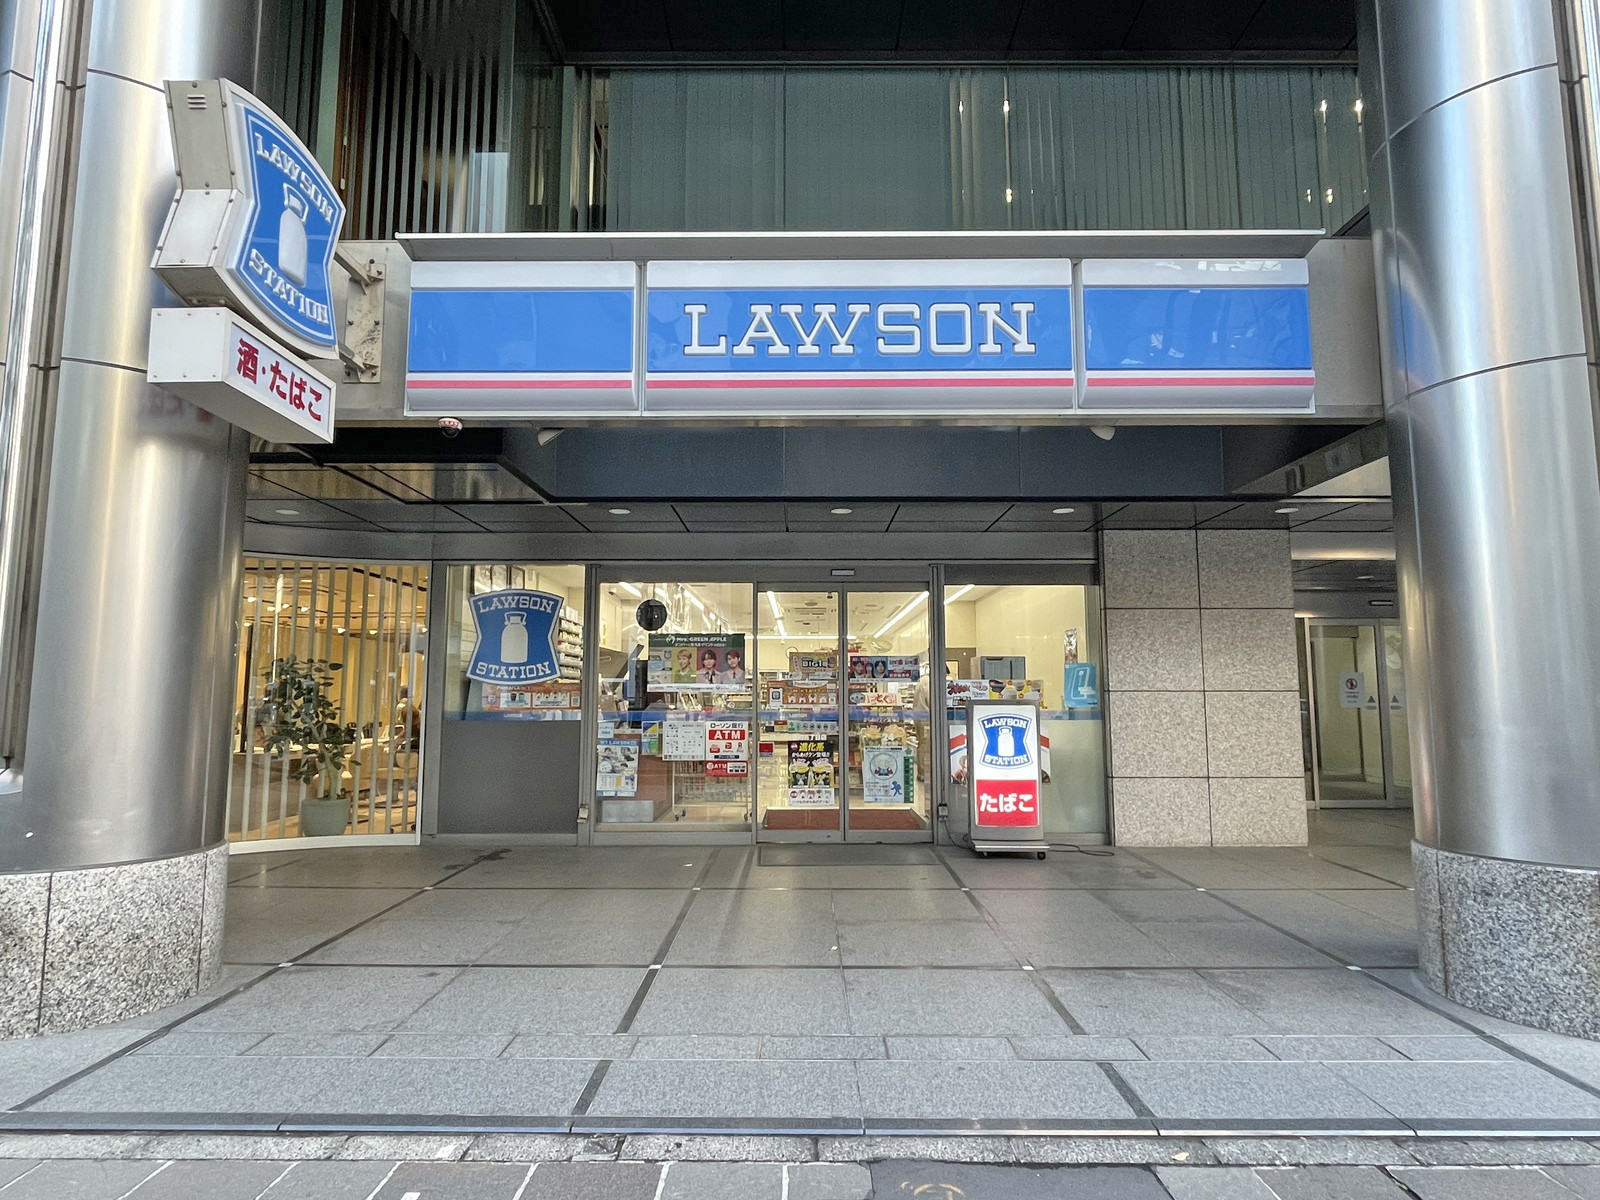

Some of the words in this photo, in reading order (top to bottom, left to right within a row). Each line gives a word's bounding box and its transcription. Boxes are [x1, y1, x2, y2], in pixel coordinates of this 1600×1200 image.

[254, 131, 333, 225] LAWSON
[249, 247, 330, 325] STATION
[683, 302, 1037, 357] LAWSON
[237, 337, 322, 422] 酒・たばこ
[477, 595, 554, 613] LAWSON
[475, 661, 551, 679] STATION
[983, 718, 1027, 729] LAWSON
[713, 730, 741, 740] ATM
[799, 742, 825, 752] 進化系
[984, 754, 1029, 766] STATION
[979, 793, 1034, 812] たばこ
